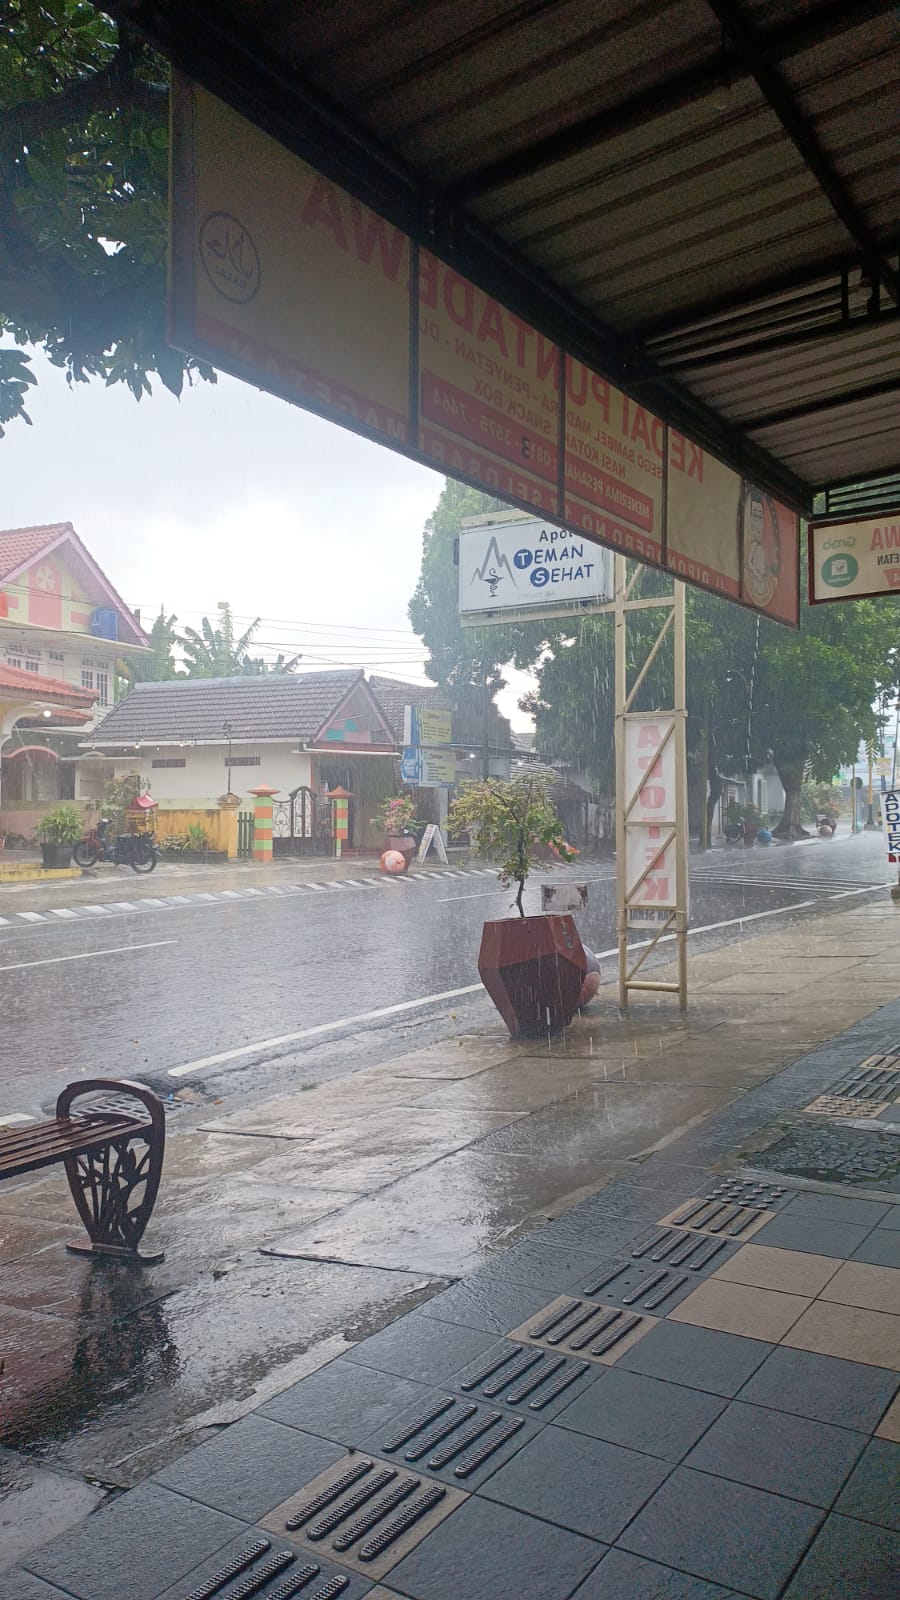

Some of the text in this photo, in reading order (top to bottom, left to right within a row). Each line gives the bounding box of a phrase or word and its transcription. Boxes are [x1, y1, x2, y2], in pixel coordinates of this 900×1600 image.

[514, 543, 584, 570] TEMAN
[530, 563, 596, 588] SEHAT
[884, 793, 900, 852] APOTEK
